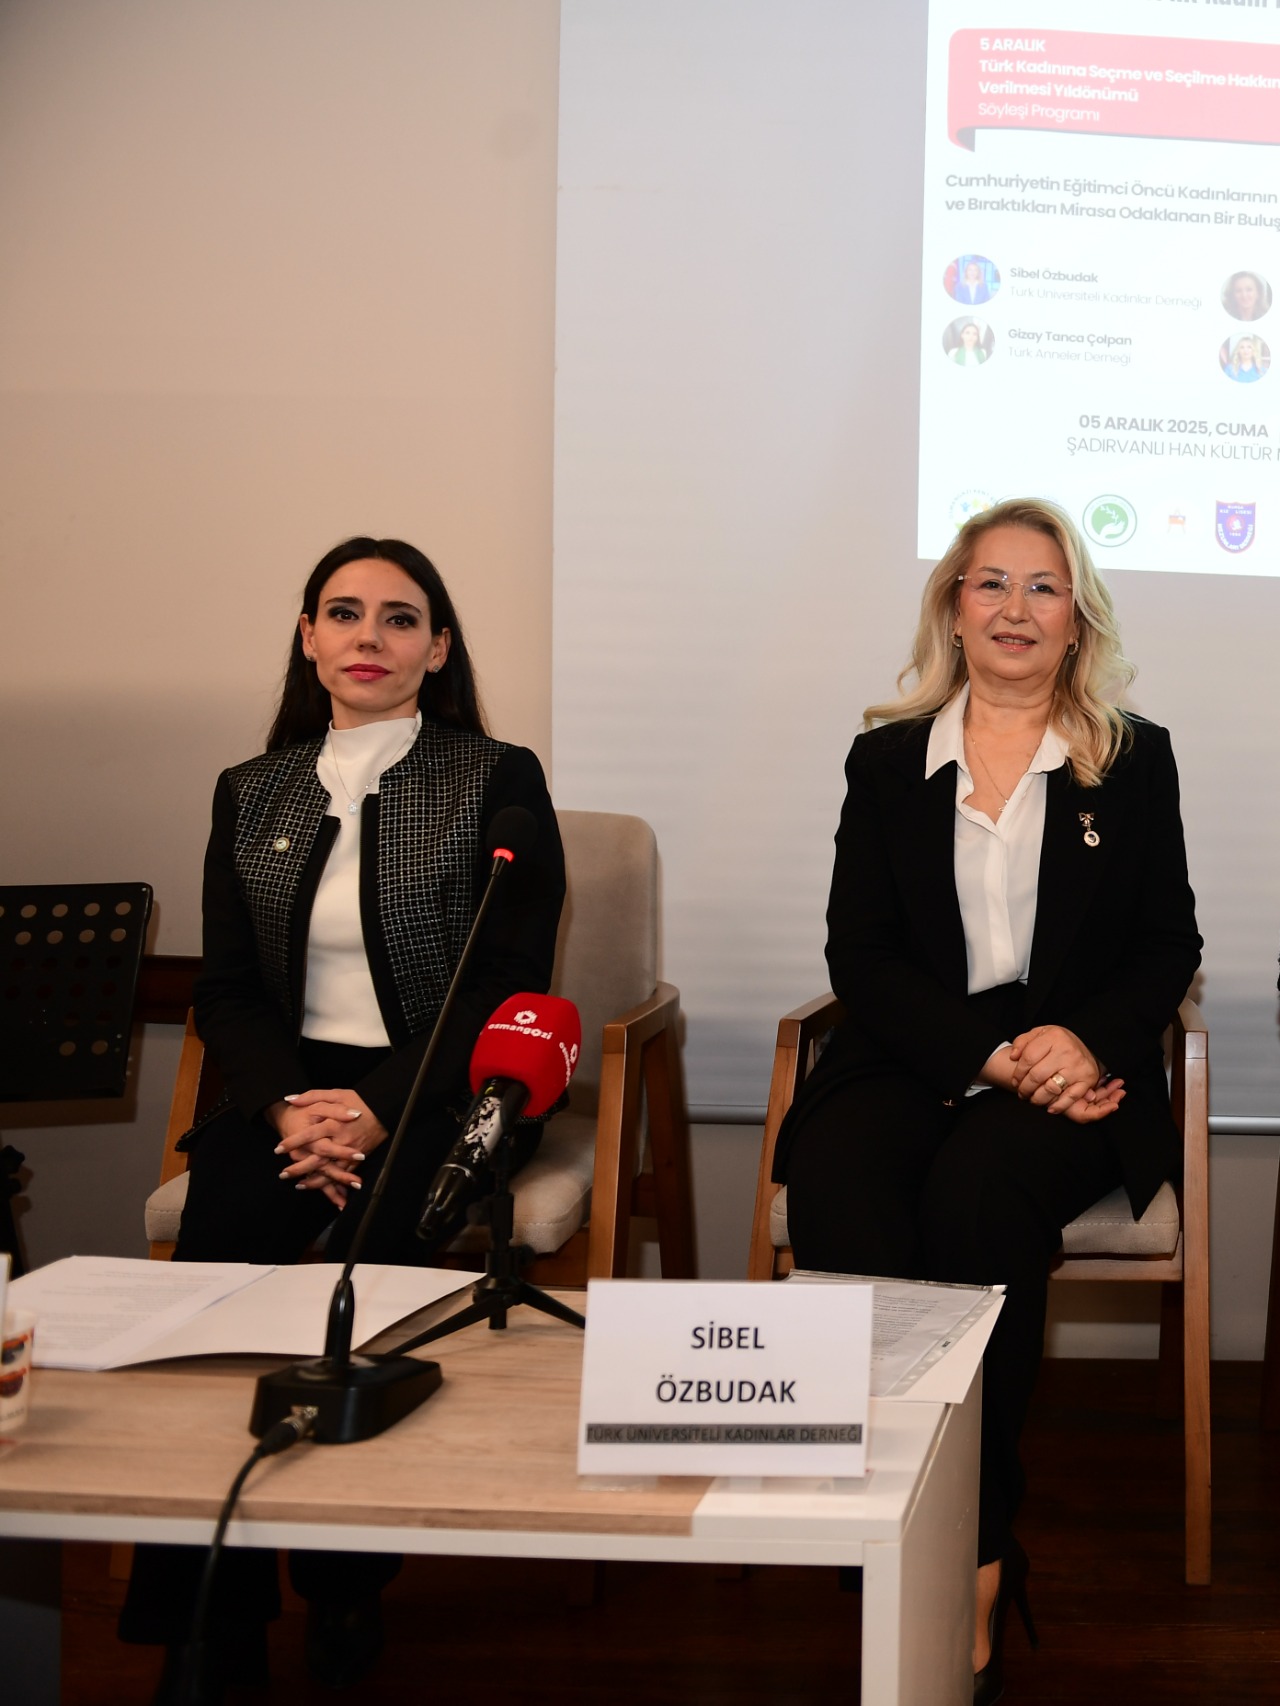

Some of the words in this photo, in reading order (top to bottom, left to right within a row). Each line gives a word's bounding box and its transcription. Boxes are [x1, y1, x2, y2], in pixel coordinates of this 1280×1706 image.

[980, 38, 990, 51] 5
[992, 39, 1046, 52] ARALIK
[979, 59, 1013, 73] Türk
[1016, 60, 1085, 77] Kadınına
[1089, 65, 1141, 83] Seçme
[1144, 70, 1162, 82] ve
[1166, 70, 1226, 88] Seçilme
[978, 81, 1051, 96] Verilmesi
[1054, 84, 1139, 102] Yıldönümü
[978, 103, 1028, 119] Söyleşi
[1032, 104, 1100, 123] Programı
[945, 173, 1060, 193] Cumhuriyetin
[1063, 178, 1128, 197] Eğitimci
[1131, 180, 1174, 198] Öncü
[1178, 186, 1278, 204] Kadınlarının
[945, 199, 965, 211] ve
[968, 197, 1056, 215] Bıraktıkları
[1060, 202, 1116, 218] Mirasa
[1119, 206, 1210, 224] Odaklanan
[1214, 210, 1235, 225] Bir
[1010, 267, 1040, 280] Sibel
[1042, 267, 1098, 283] Özbudak
[1008, 328, 1043, 344] Gizay
[1046, 331, 1085, 343] Tanca
[1086, 333, 1132, 348] Çolpan
[1036, 348, 1080, 361] Anneler
[1078, 414, 1100, 429] 05
[1104, 416, 1164, 432] ARALIK
[1167, 419, 1212, 437] 2025,
[1216, 422, 1269, 438] CUMA
[1066, 436, 1164, 456] ŞADIRVANLI
[1169, 442, 1206, 458] HAN
[1210, 442, 1272, 461] KÜLTÜR
[690, 1320, 766, 1350] SİBEL
[656, 1374, 797, 1404] ÖZBUDAK
[724, 1428, 795, 1442] KADINLAR
